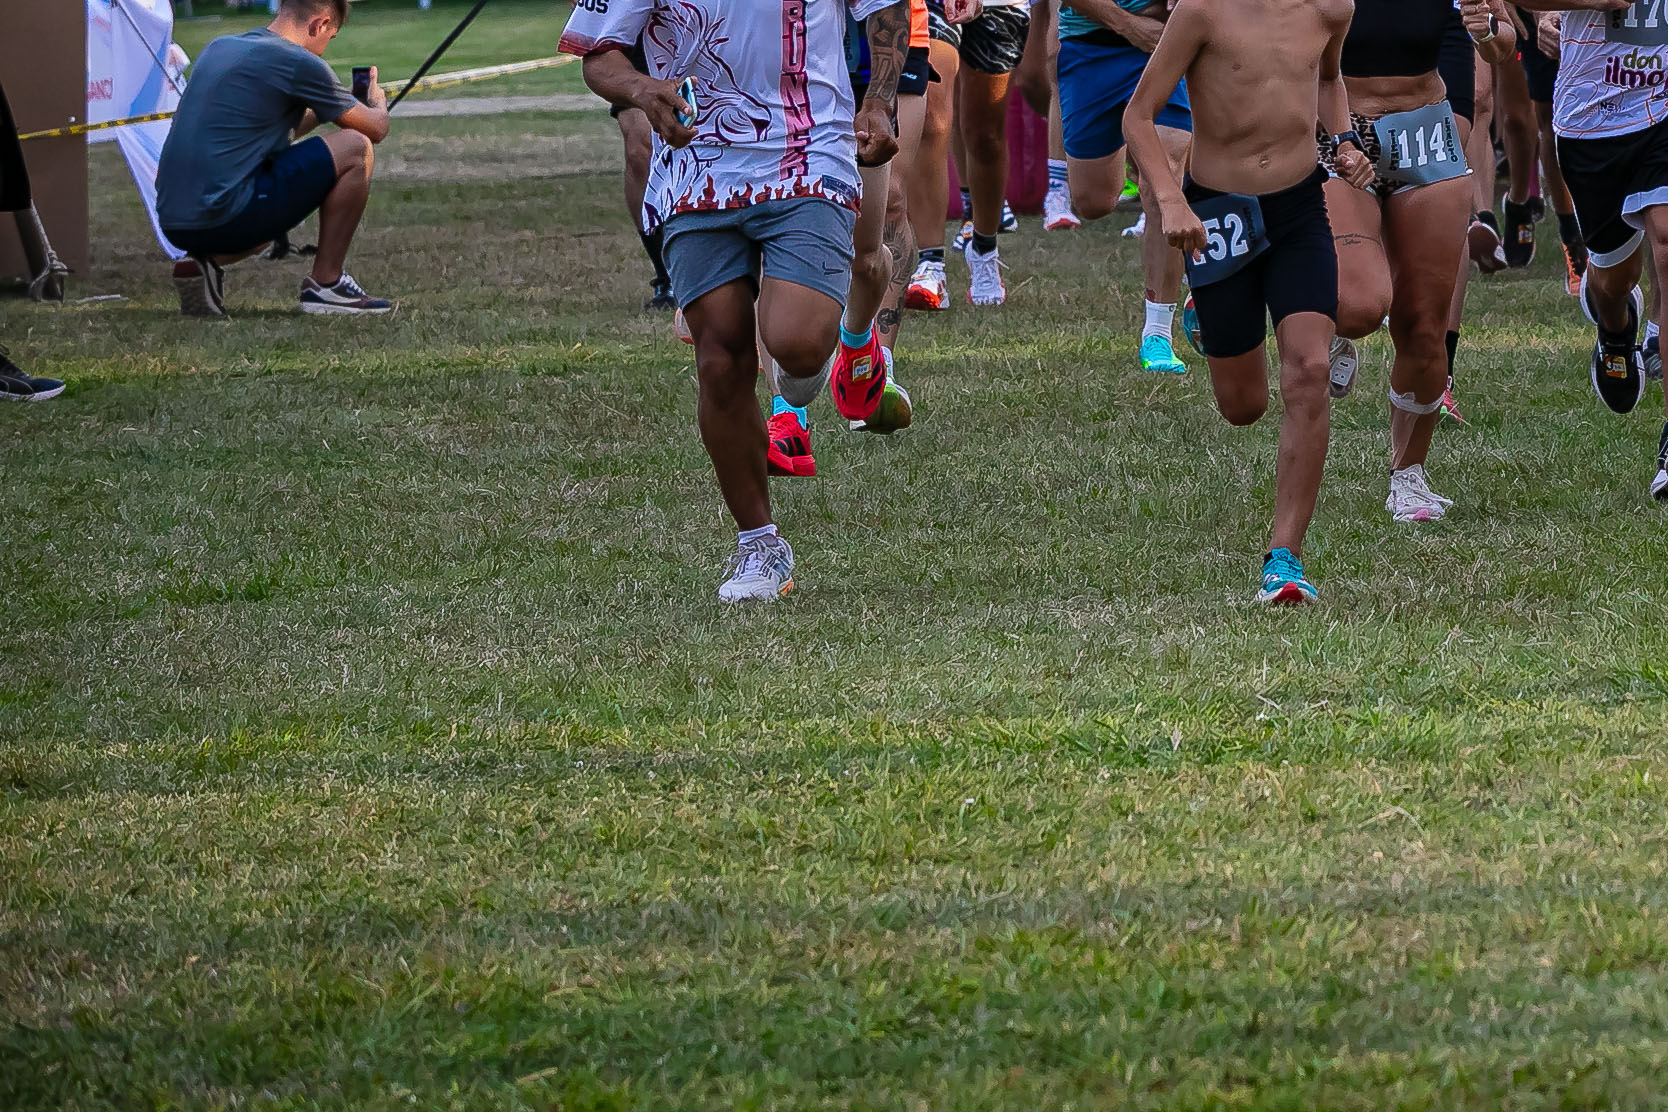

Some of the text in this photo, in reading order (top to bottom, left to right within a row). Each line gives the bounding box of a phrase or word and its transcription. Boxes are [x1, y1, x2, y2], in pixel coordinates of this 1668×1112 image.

[1604, 55, 1666, 89] ilmo
[1623, 47, 1663, 70] don
[1398, 122, 1447, 168] 114
[1444, 116, 1459, 163] EXACTO
